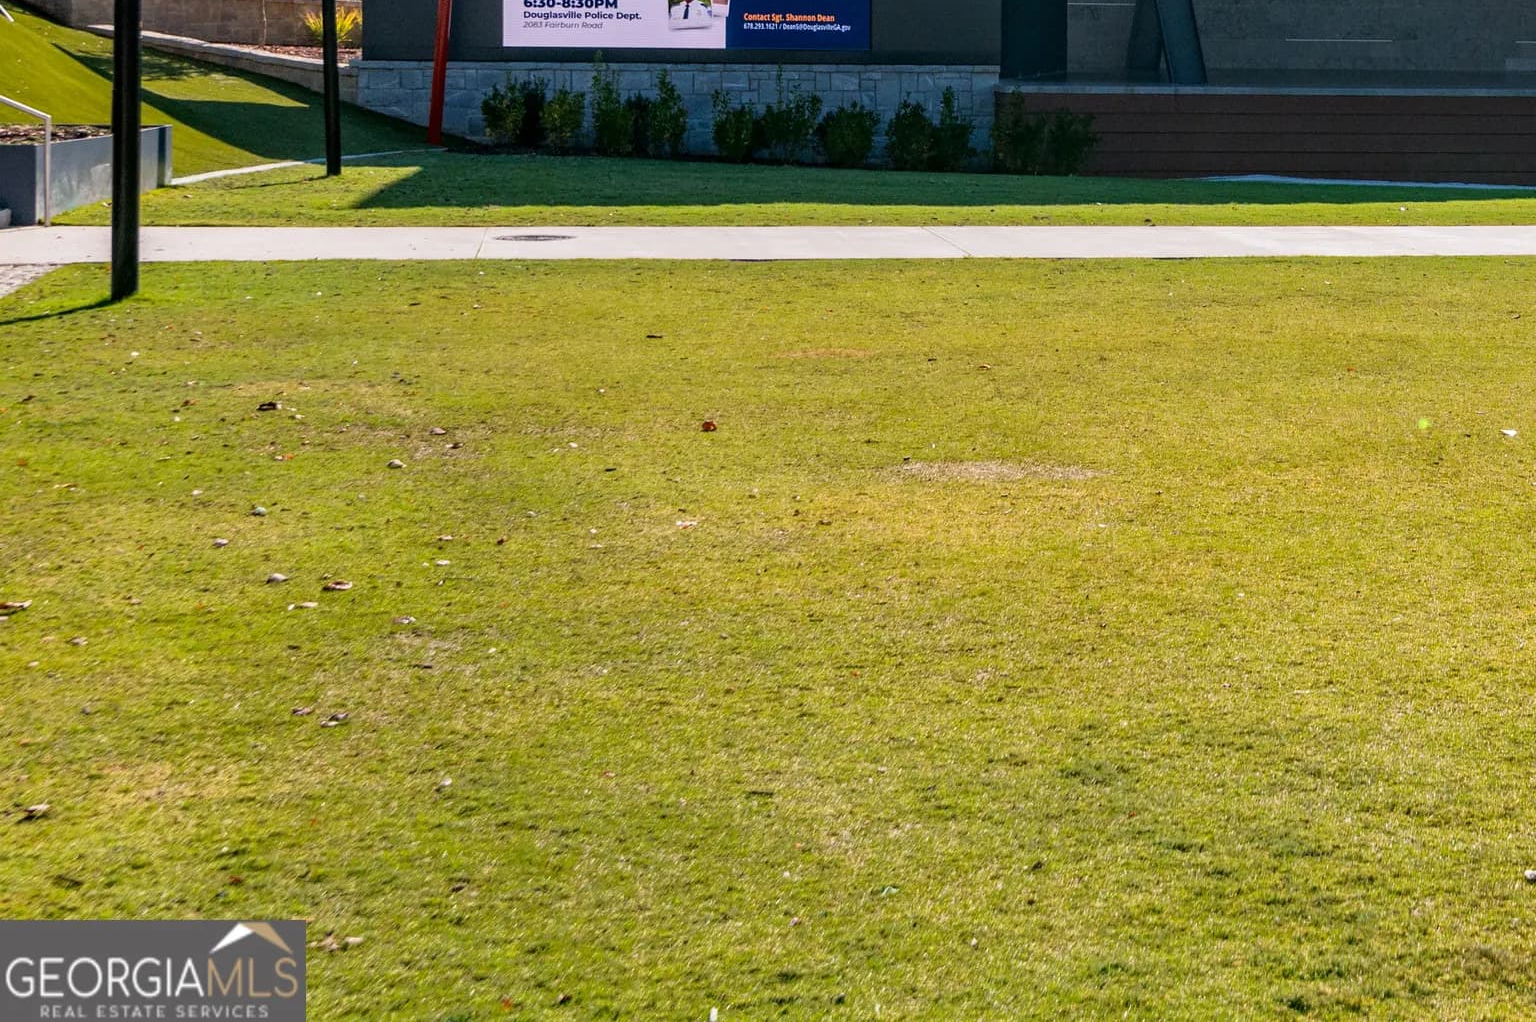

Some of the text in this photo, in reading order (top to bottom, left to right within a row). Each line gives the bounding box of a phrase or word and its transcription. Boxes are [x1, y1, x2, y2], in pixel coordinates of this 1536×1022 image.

[523, 11, 642, 21] Douglasville Police Dept.
[743, 12, 835, 23] Contact Sgt. Shannon Dean
